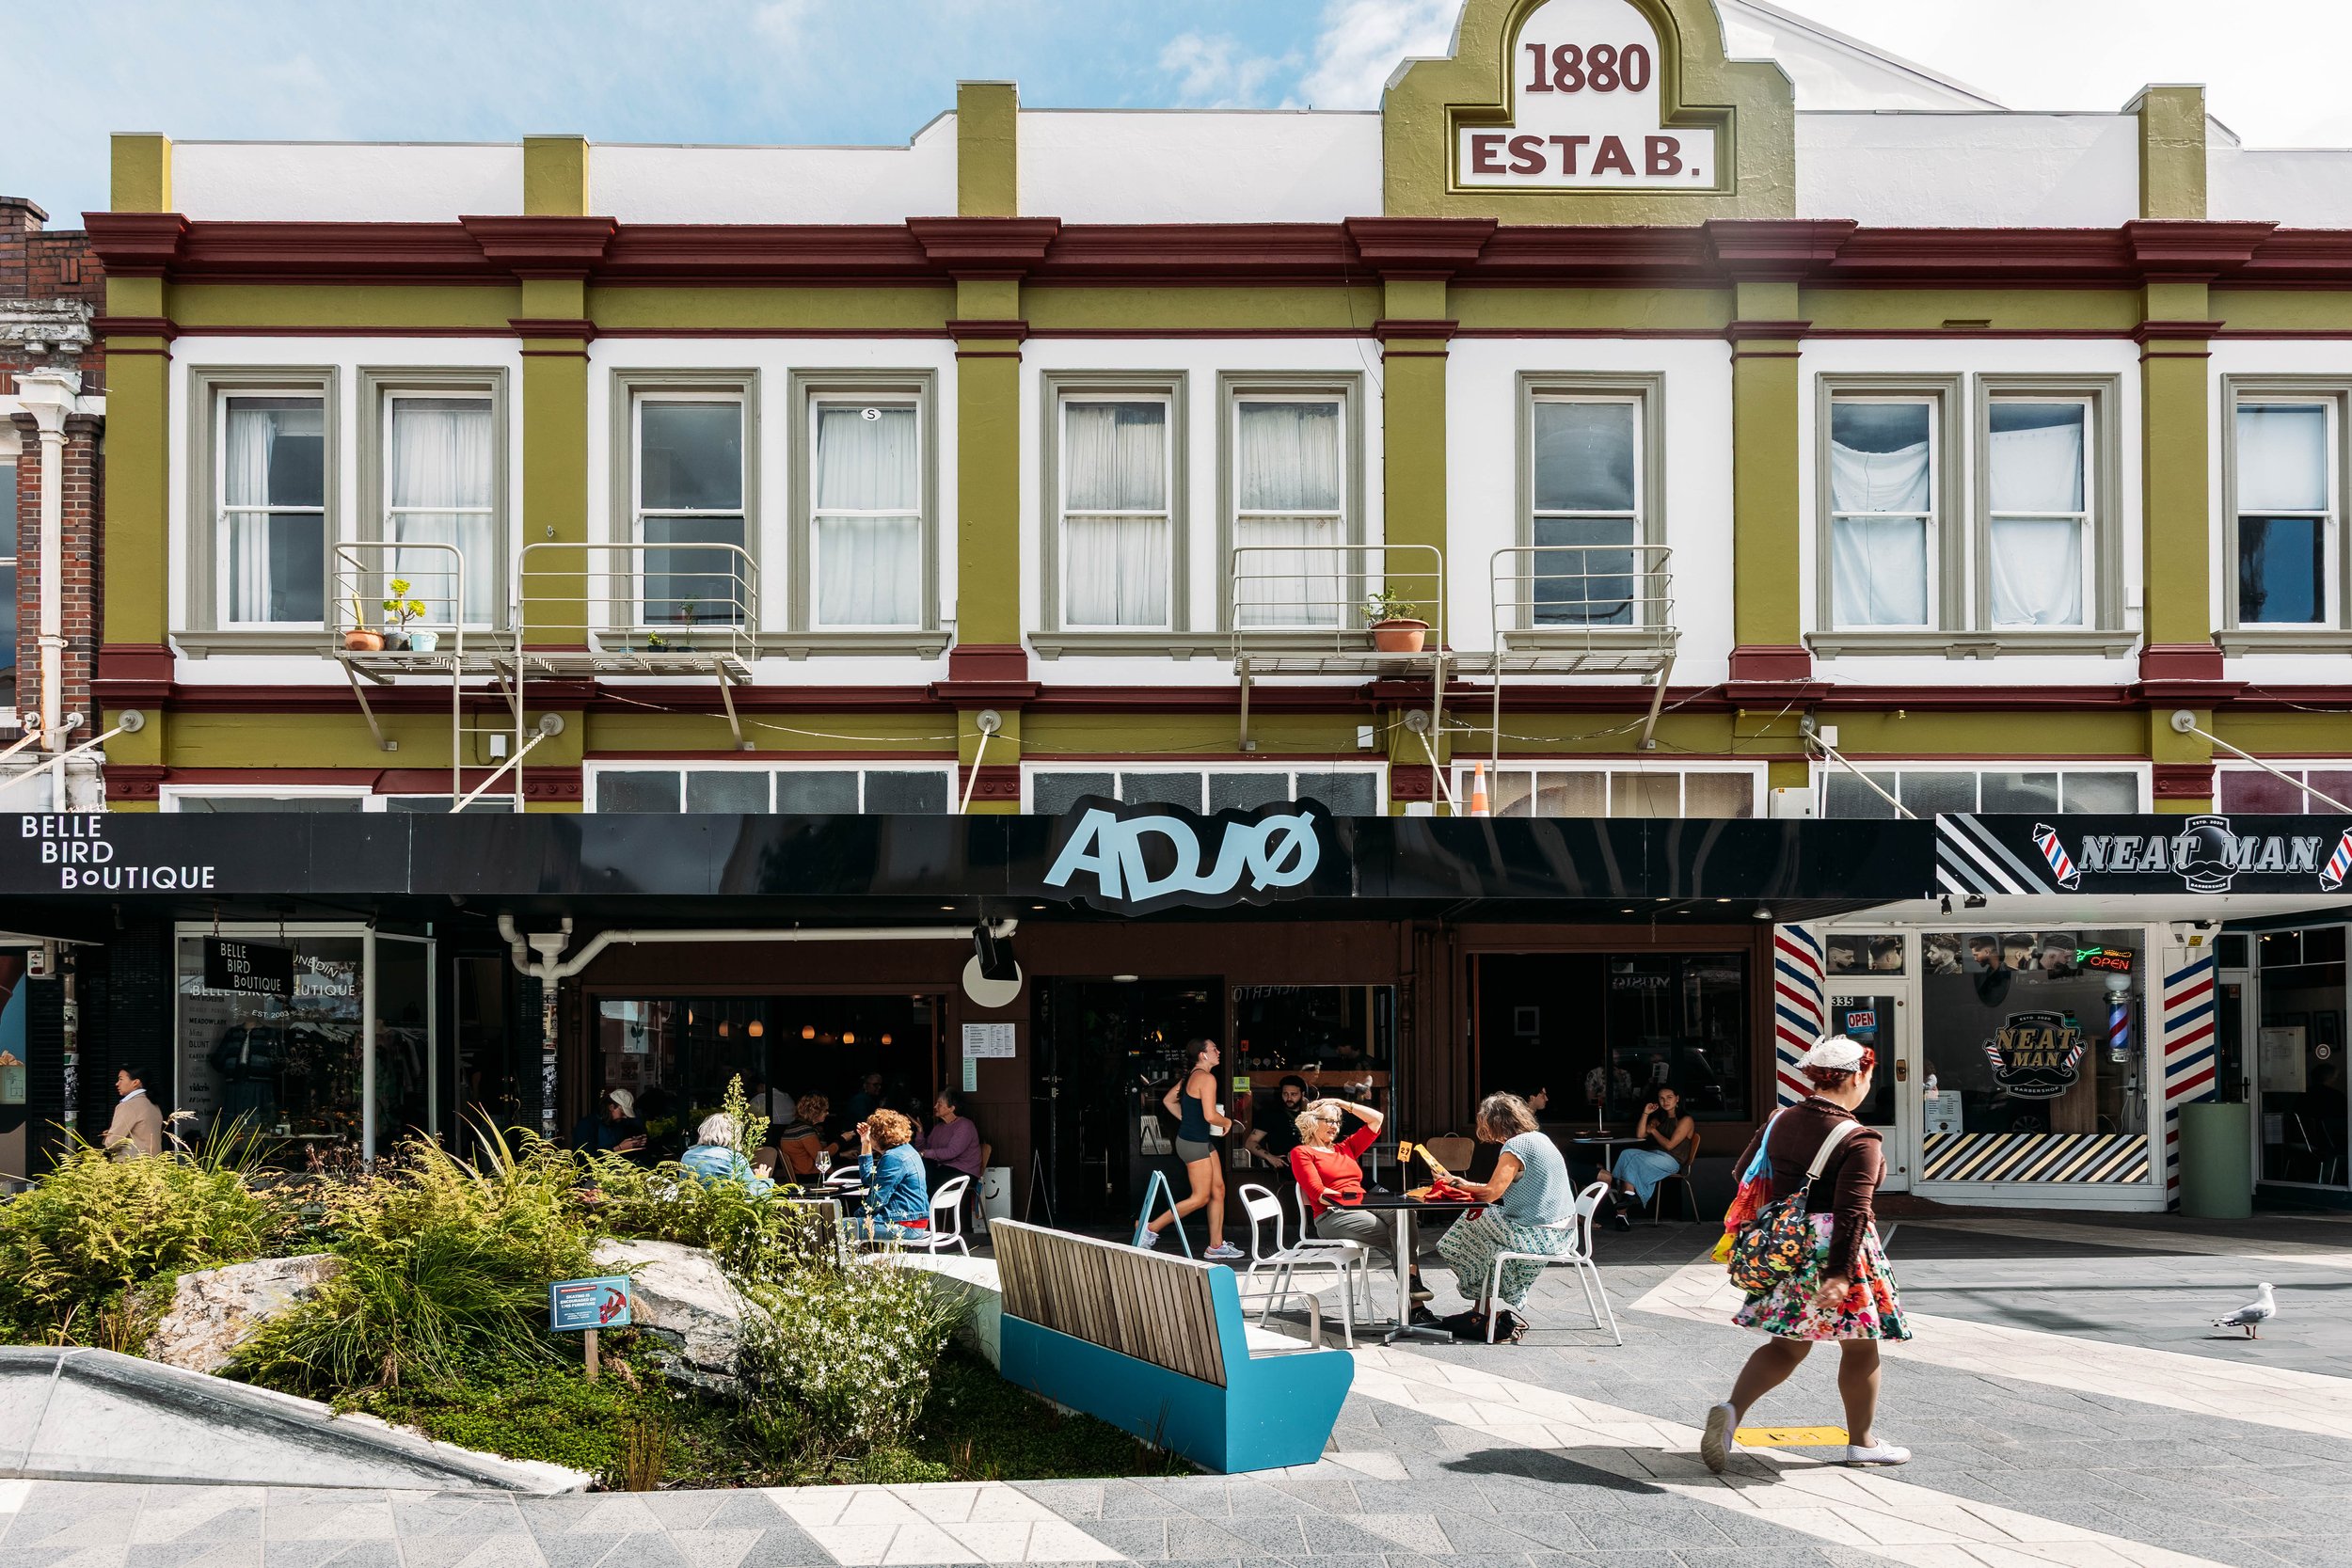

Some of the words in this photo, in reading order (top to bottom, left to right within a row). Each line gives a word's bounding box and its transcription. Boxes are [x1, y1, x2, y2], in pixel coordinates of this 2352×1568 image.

[1526, 43, 1651, 92] 1880
[1471, 135, 1700, 176] ESTAB.
[867, 410, 876, 420] S
[22, 816, 102, 837] BELLE
[41, 841, 114, 863] BIRD
[2078, 835, 2201, 873] NEAT
[2219, 835, 2323, 873] MAN
[220, 942, 246, 958] BELLE
[227, 959, 251, 974] BIRD
[2090, 957, 2130, 970] OPEN
[1831, 997, 1852, 1006] 335
[271, 1010, 290, 1019] 2003
[1848, 1013, 1874, 1027] OPEN
[1996, 1027, 2076, 1051] NEAT
[2012, 1052, 2060, 1068] MAN
[2014, 1085, 2059, 1094] BARBERSHOP
[1400, 1147, 1410, 1156] 29
